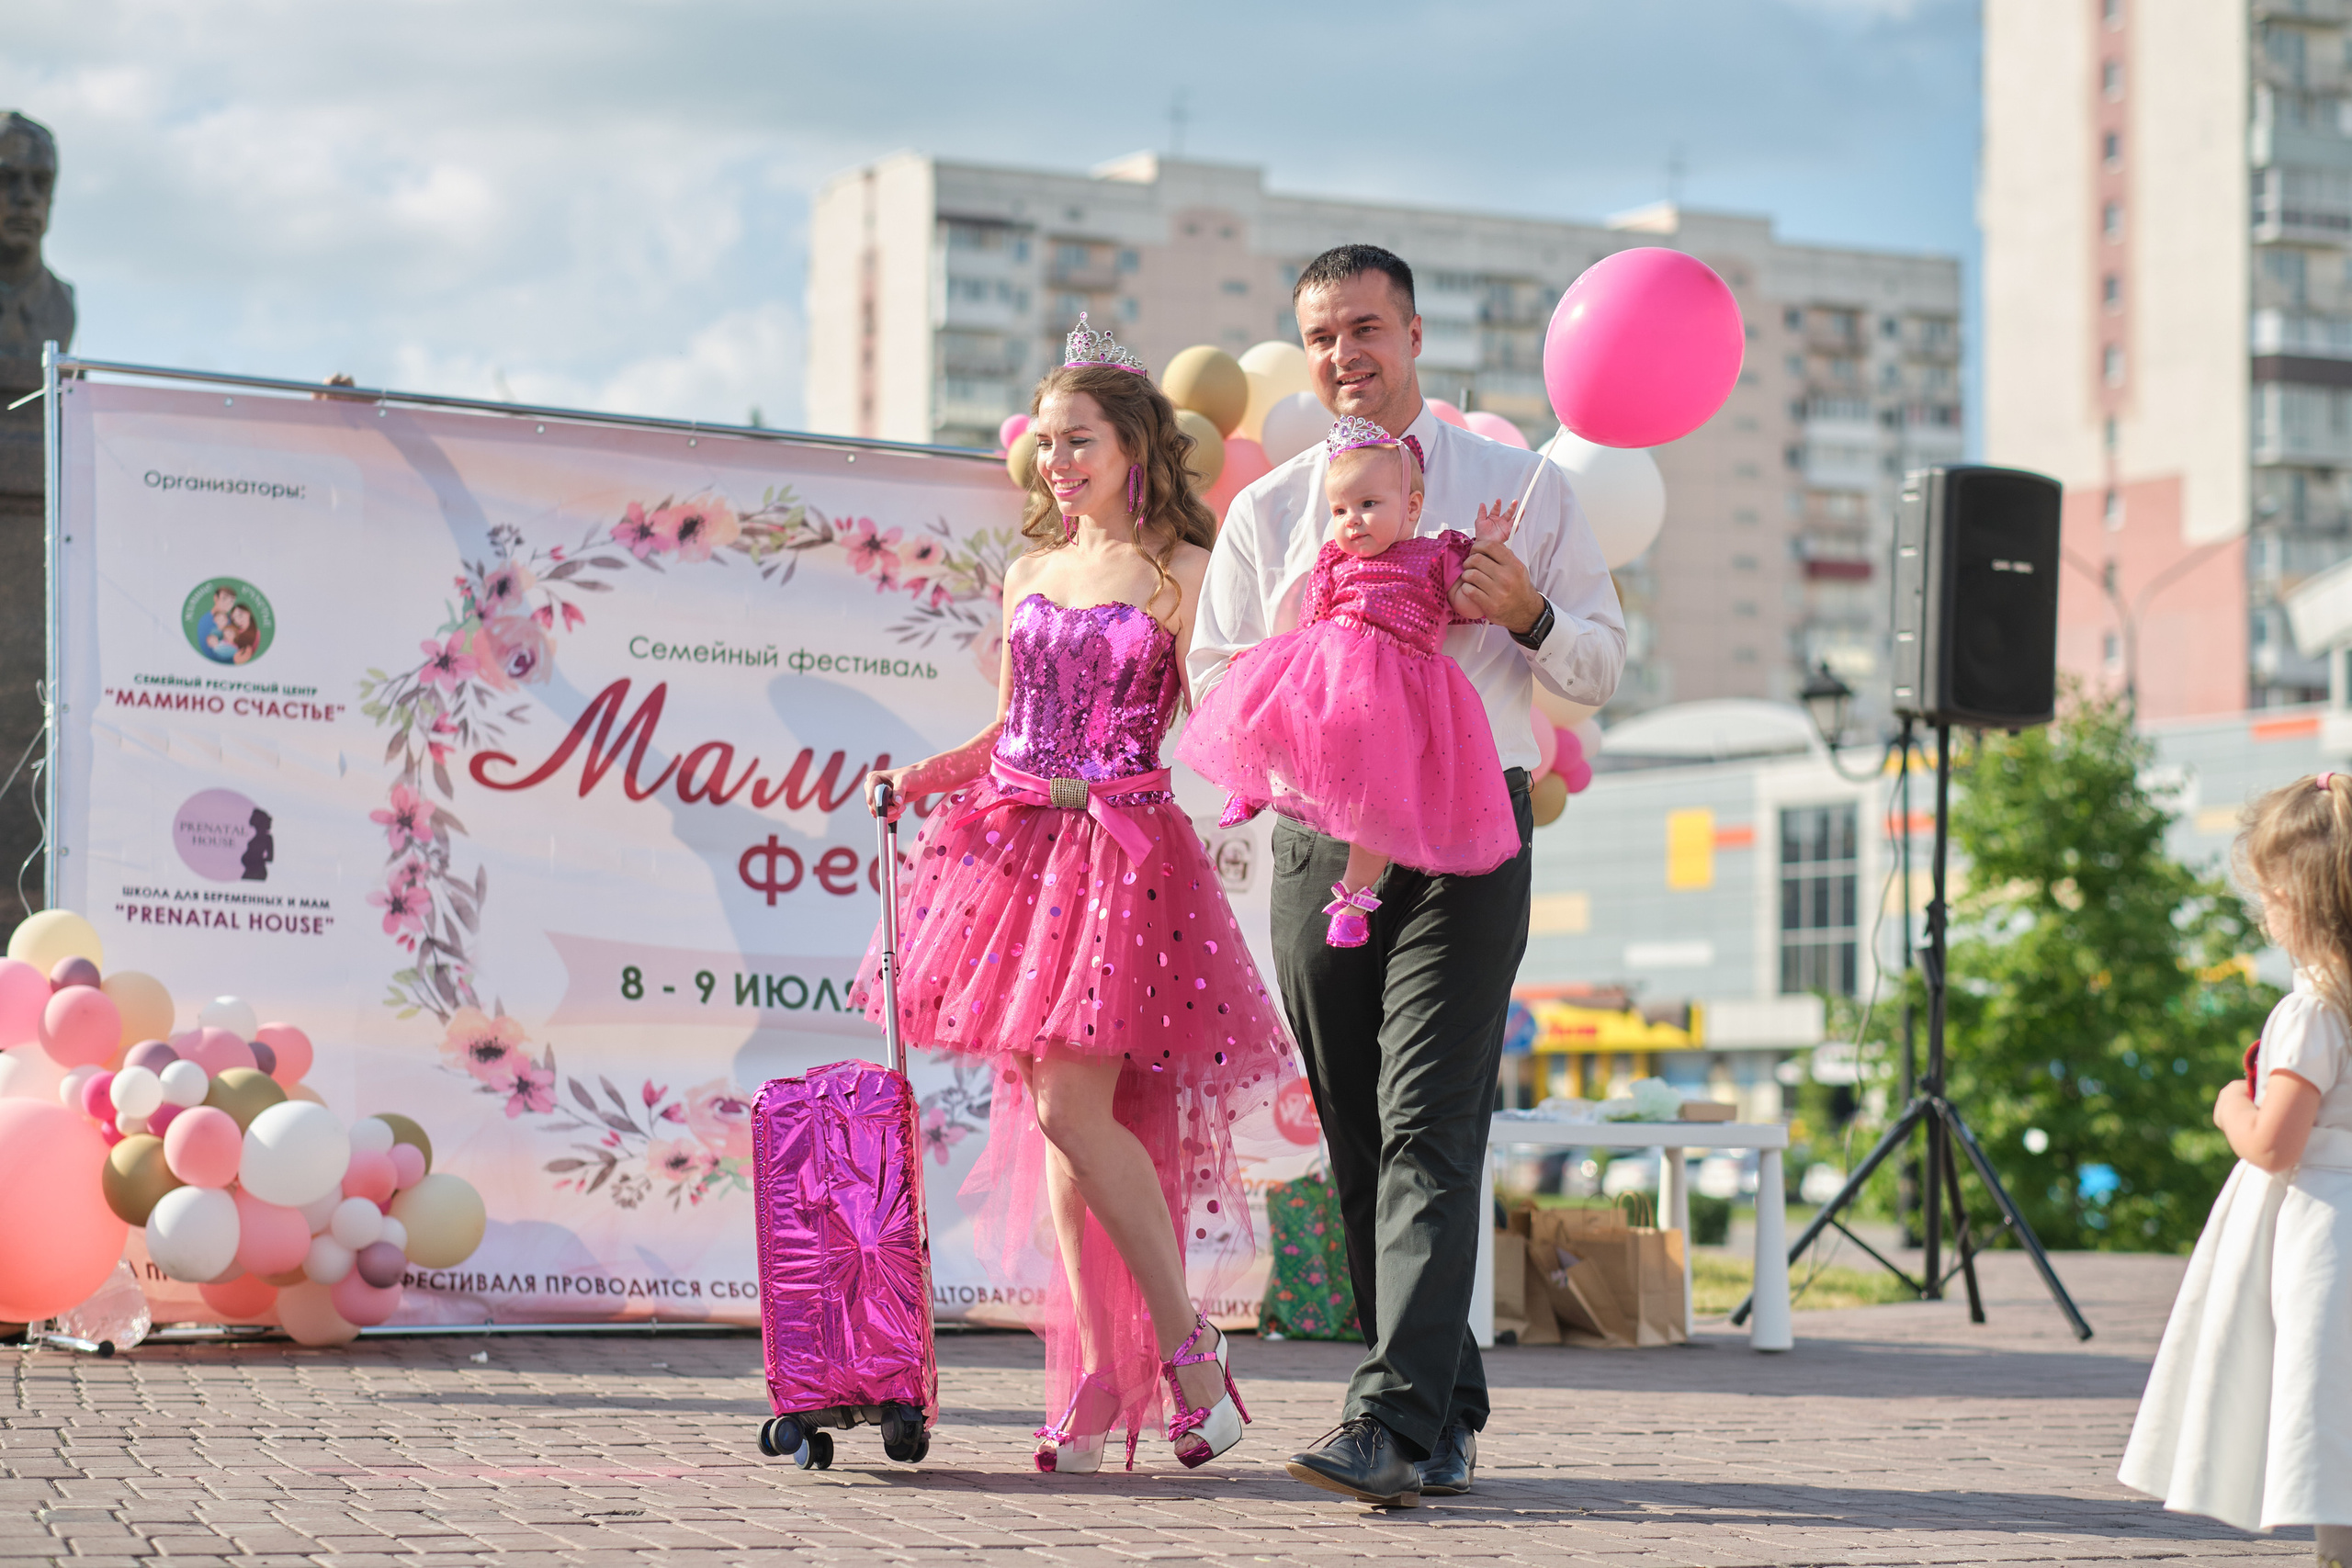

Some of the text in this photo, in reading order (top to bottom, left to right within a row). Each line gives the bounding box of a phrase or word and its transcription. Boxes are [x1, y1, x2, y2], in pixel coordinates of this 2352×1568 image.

[629, 636, 939, 680] Семейный фестиваль
[134, 673, 319, 698] СЕМЕЙНЫЙ РЕСУРСНЫЙ ЦЕНТР
[105, 688, 346, 723] "МАМИНО СЧАСТЬЕ"
[122, 885, 331, 910] ШКОЛА ДЛЯ БЕРЕМЕННЫХ И МАМ
[116, 903, 334, 935] "PRENATAL HOUSE"
[621, 965, 644, 1000] 8
[695, 969, 716, 1004] 9
[546, 1274, 702, 1299] ПРОВОДИТСЯ
[710, 1280, 759, 1299] СБО
